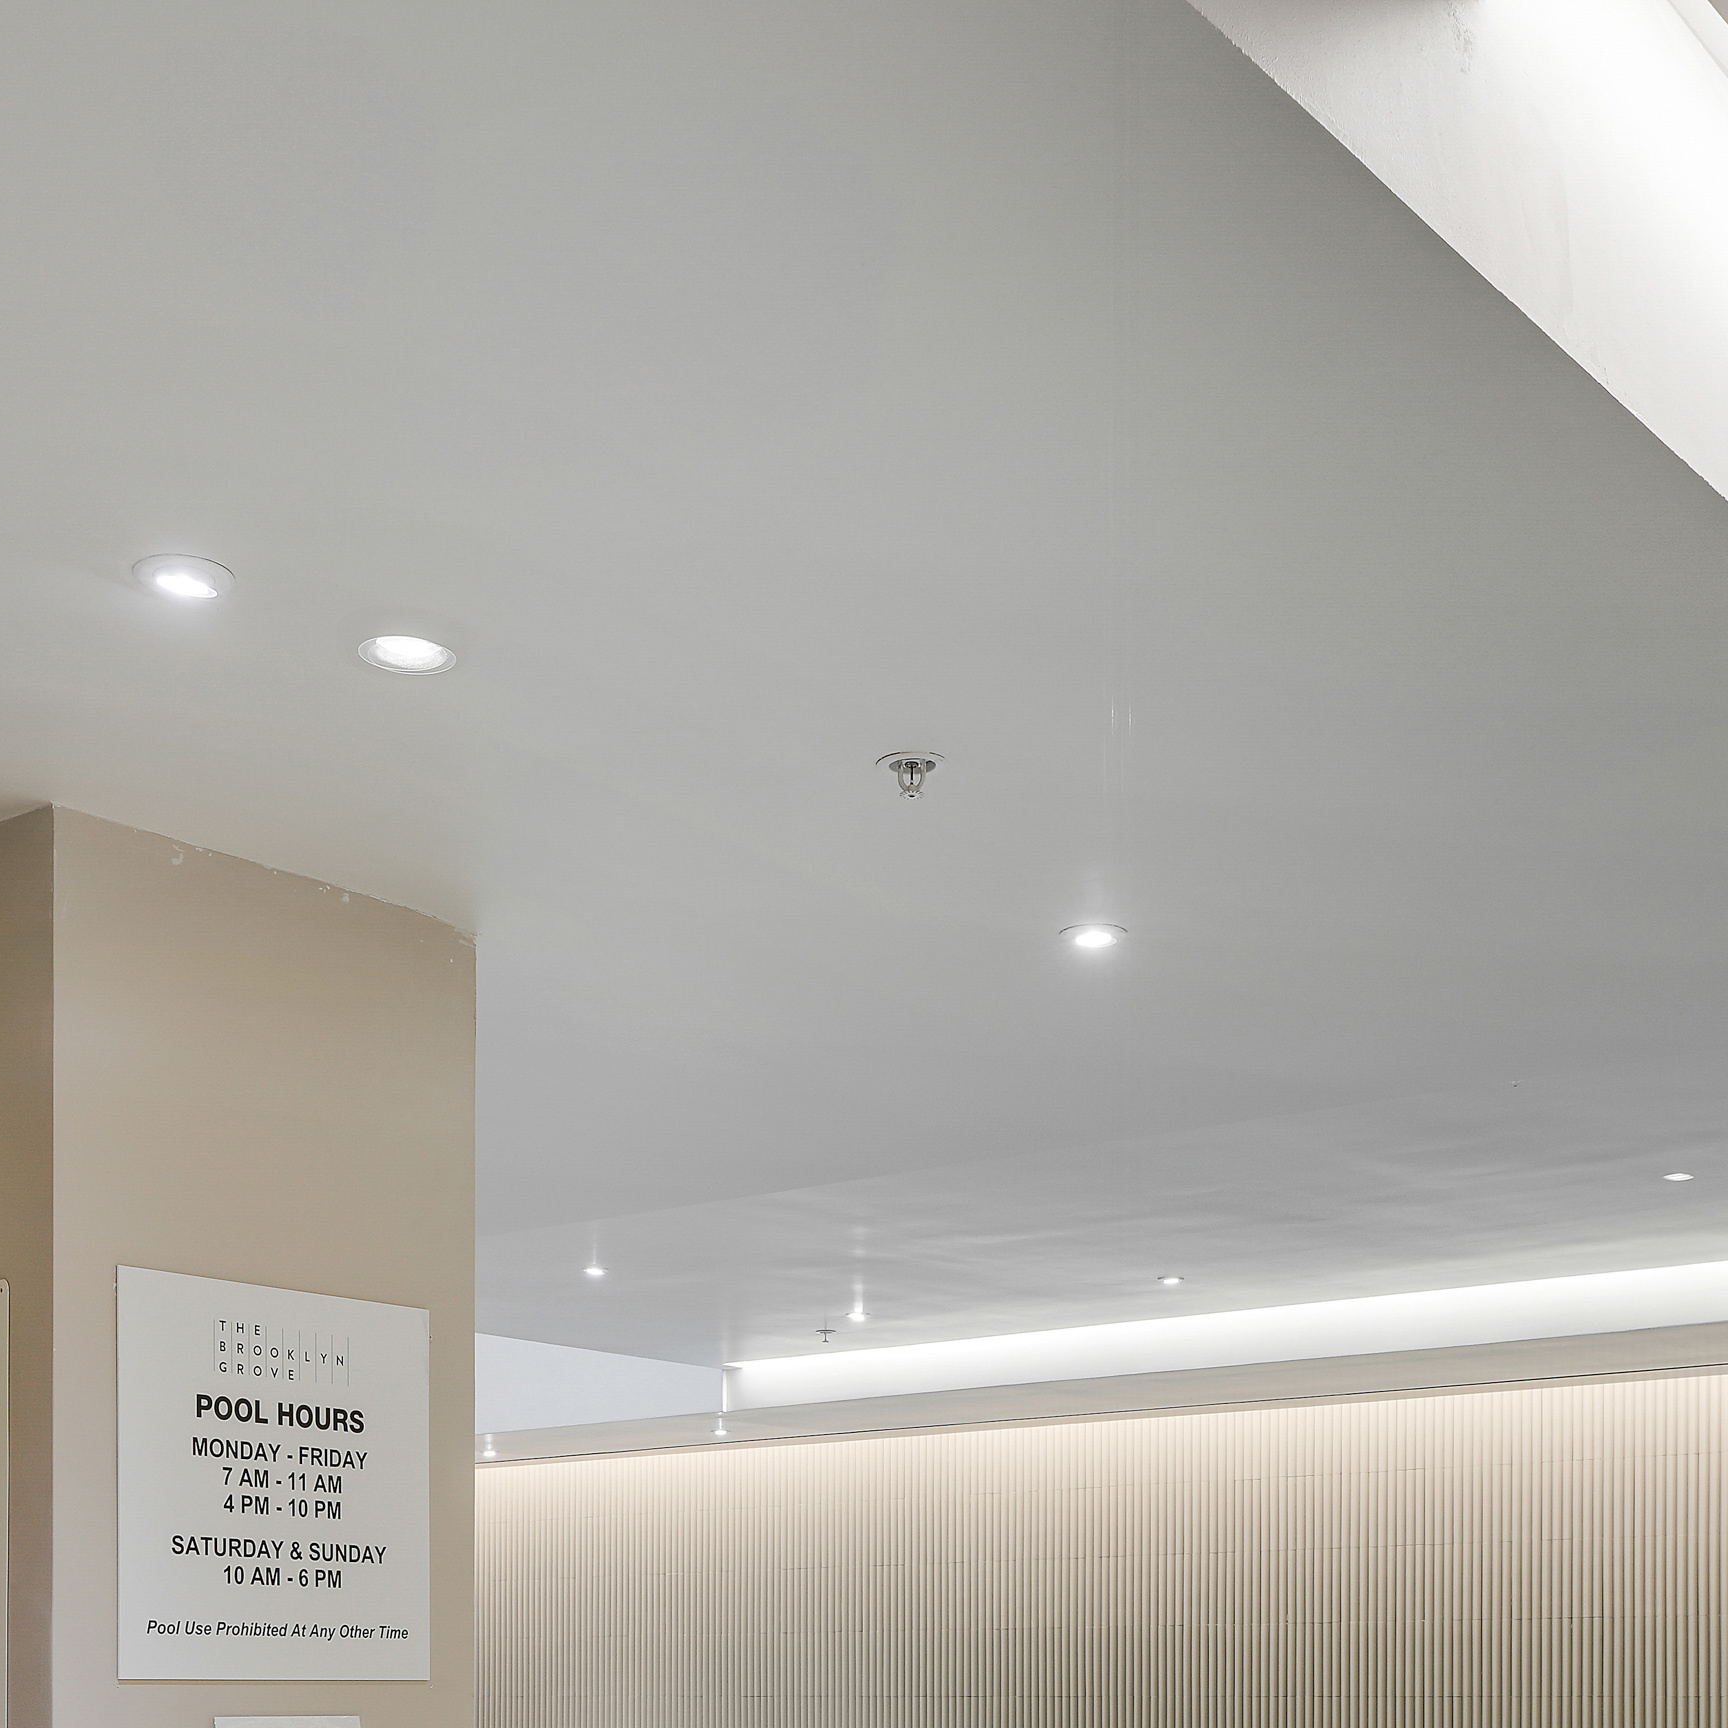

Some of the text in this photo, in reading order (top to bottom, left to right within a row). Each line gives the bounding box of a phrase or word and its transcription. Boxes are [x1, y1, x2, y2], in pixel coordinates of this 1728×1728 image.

[220, 1320, 260, 1336] THE
[220, 1341, 344, 1366] BROOKLYN
[219, 1362, 294, 1381] GROVE
[195, 1393, 365, 1433] POOL HOURS
[192, 1436, 281, 1464] MONDAY
[298, 1446, 368, 1470] FRIDAY
[222, 1467, 232, 1485] 7
[239, 1469, 270, 1489] AM
[287, 1472, 307, 1491] 11
[313, 1475, 342, 1494] AM
[223, 1494, 235, 1513] 4
[241, 1496, 270, 1515] PM
[289, 1499, 308, 1518] 10
[314, 1501, 341, 1520] PM
[171, 1535, 387, 1564] SATURDAY & SUNDAY
[224, 1565, 244, 1585] 10
[250, 1567, 281, 1586] AM
[298, 1568, 309, 1587] 6
[315, 1570, 342, 1588] PM
[146, 1620, 409, 1642] Pool Use Prohibited At Any Other Time
